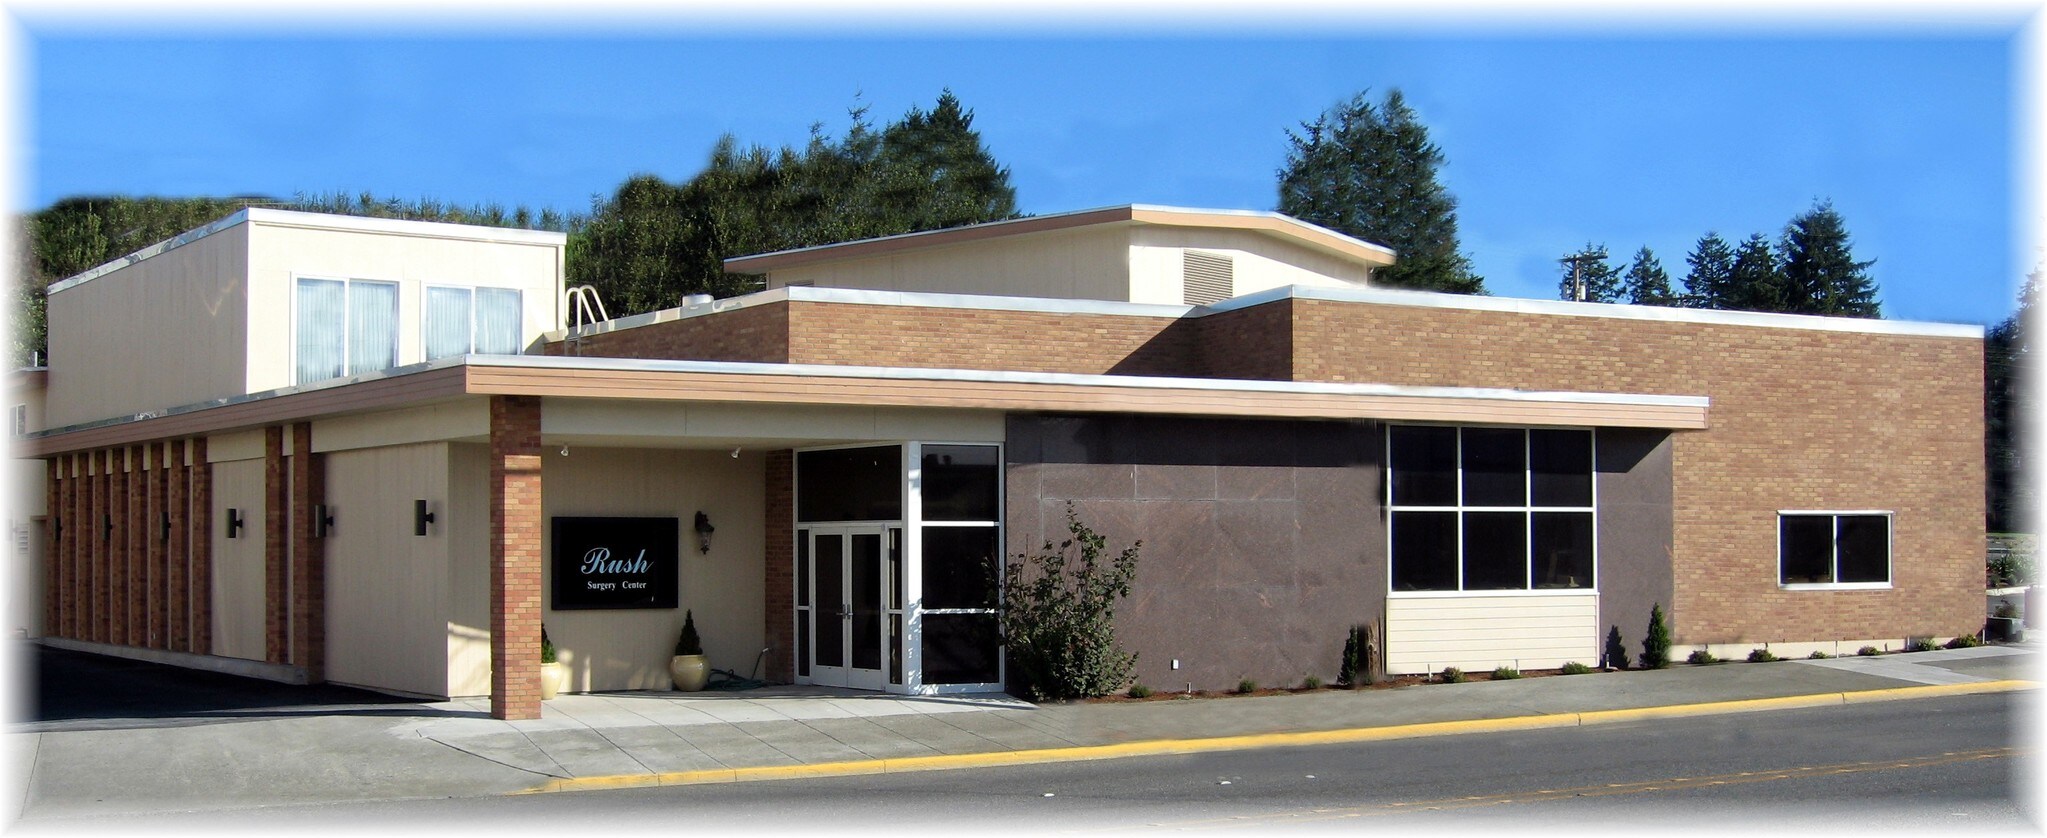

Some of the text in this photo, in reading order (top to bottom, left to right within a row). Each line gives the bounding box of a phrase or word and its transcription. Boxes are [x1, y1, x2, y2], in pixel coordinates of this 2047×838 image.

[581, 547, 654, 574] Rush
[587, 580, 647, 591] Surgery Center
